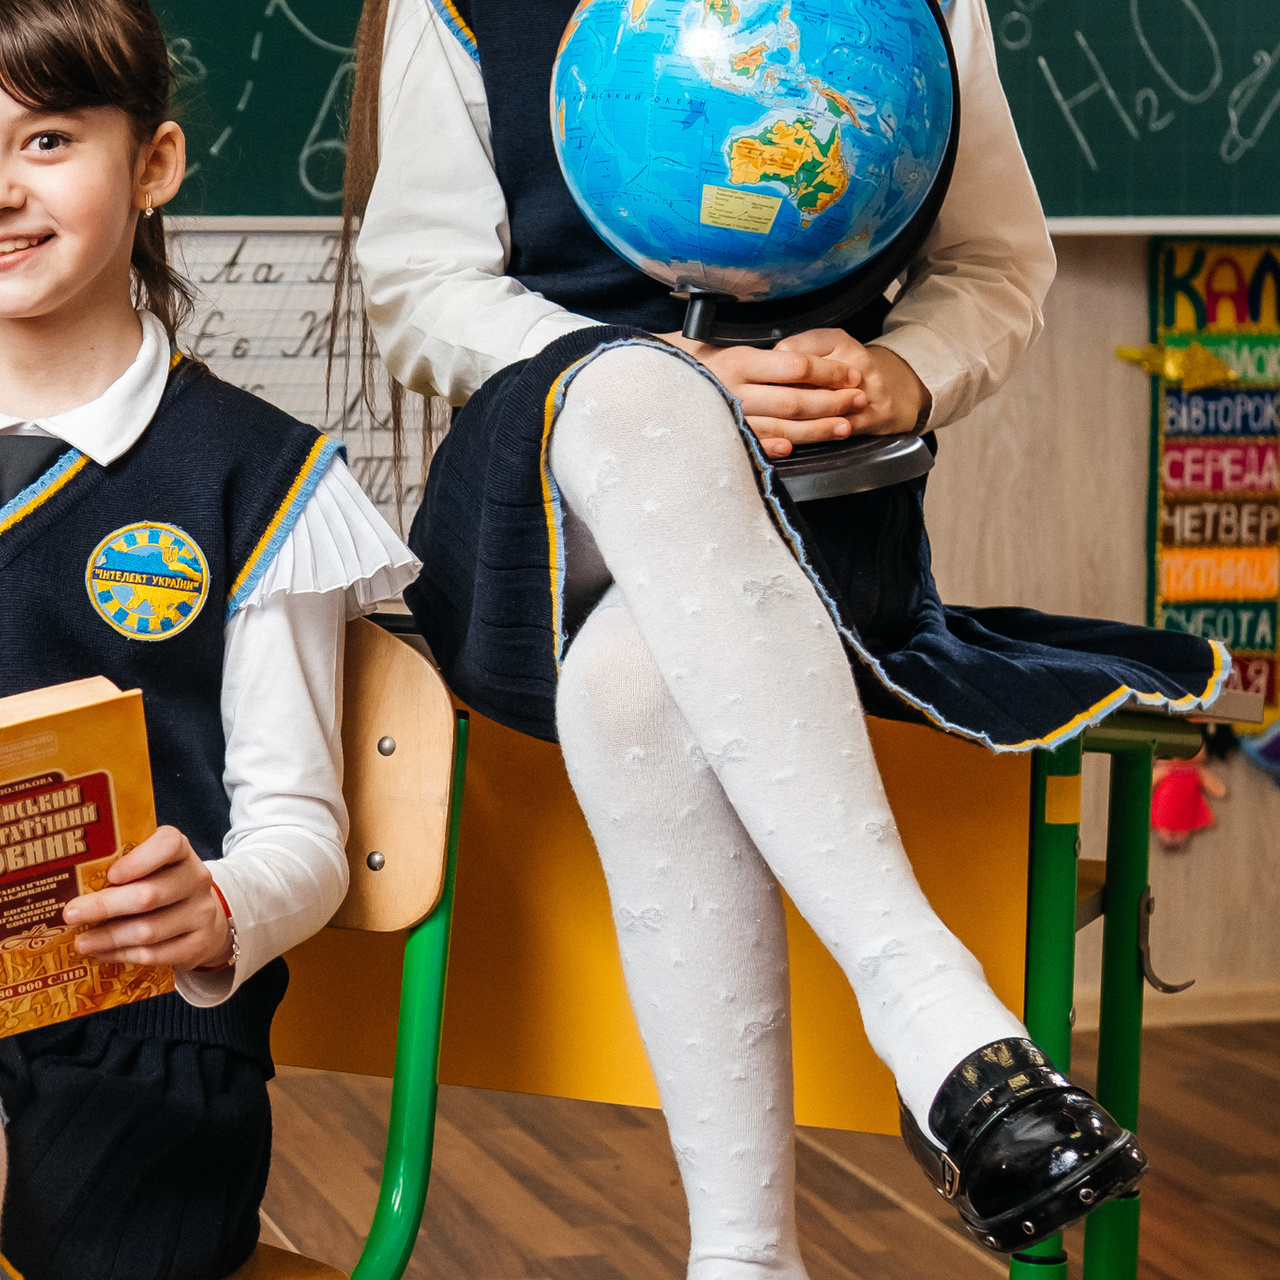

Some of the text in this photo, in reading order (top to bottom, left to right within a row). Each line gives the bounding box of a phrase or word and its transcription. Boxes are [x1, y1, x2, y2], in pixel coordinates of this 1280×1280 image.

[1163, 446, 1280, 492] СЕРЕДА
[1163, 503, 1280, 544] ЧЕТВЕР
[18, 979, 43, 994] 000
[47, 968, 86, 985] СЛІВ
